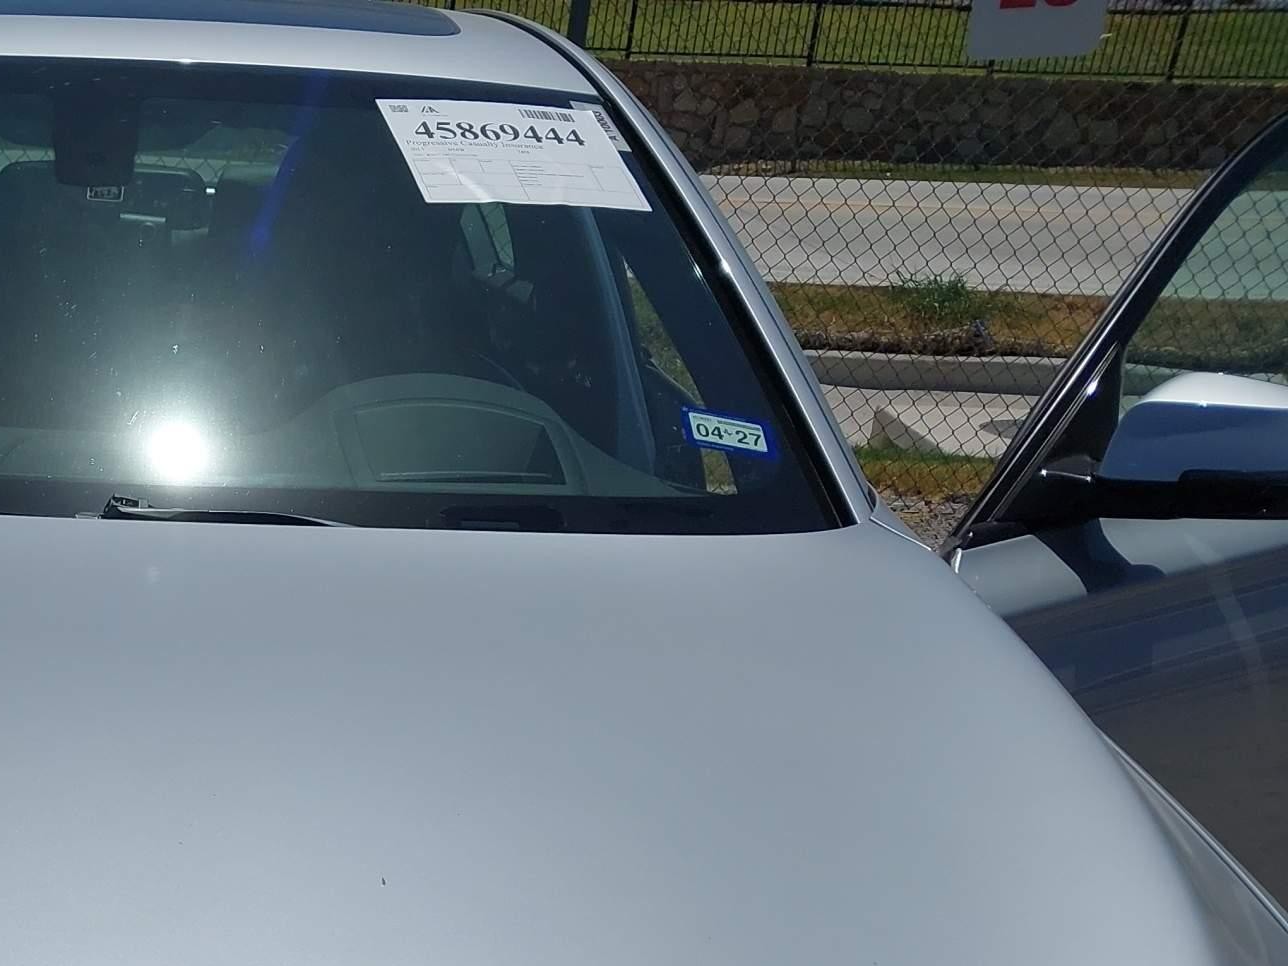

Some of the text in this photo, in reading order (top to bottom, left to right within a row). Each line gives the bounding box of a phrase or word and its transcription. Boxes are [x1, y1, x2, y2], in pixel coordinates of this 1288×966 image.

[405, 139, 544, 150] Progressive Casualty Insurance
[414, 120, 585, 146] 45869444
[695, 423, 724, 441] 04
[735, 430, 762, 447] 27
